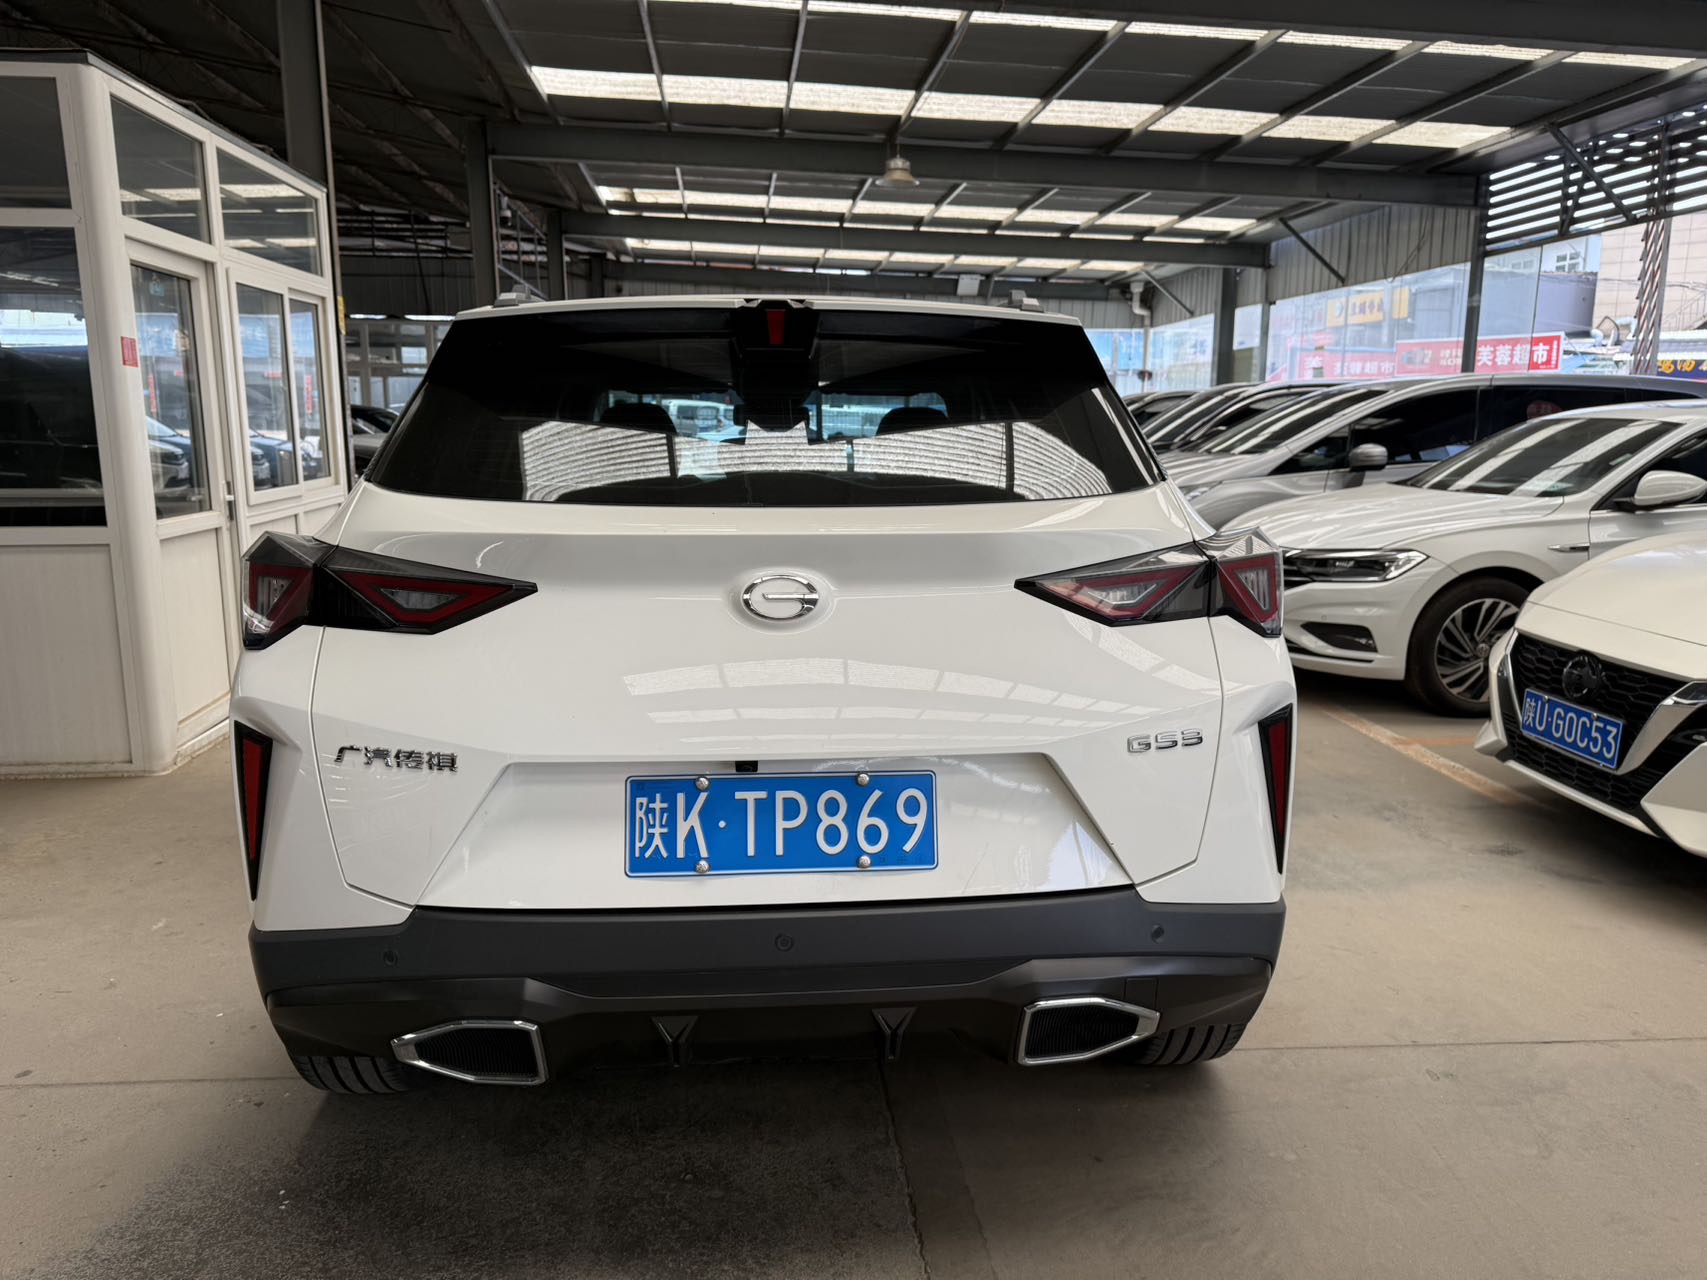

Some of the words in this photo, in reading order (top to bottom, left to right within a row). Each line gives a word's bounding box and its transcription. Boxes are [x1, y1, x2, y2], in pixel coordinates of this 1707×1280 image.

[1477, 342, 1550, 367] 芙蓉超市
[1127, 728, 1203, 753] GS3
[333, 745, 458, 772] 广汽传祺
